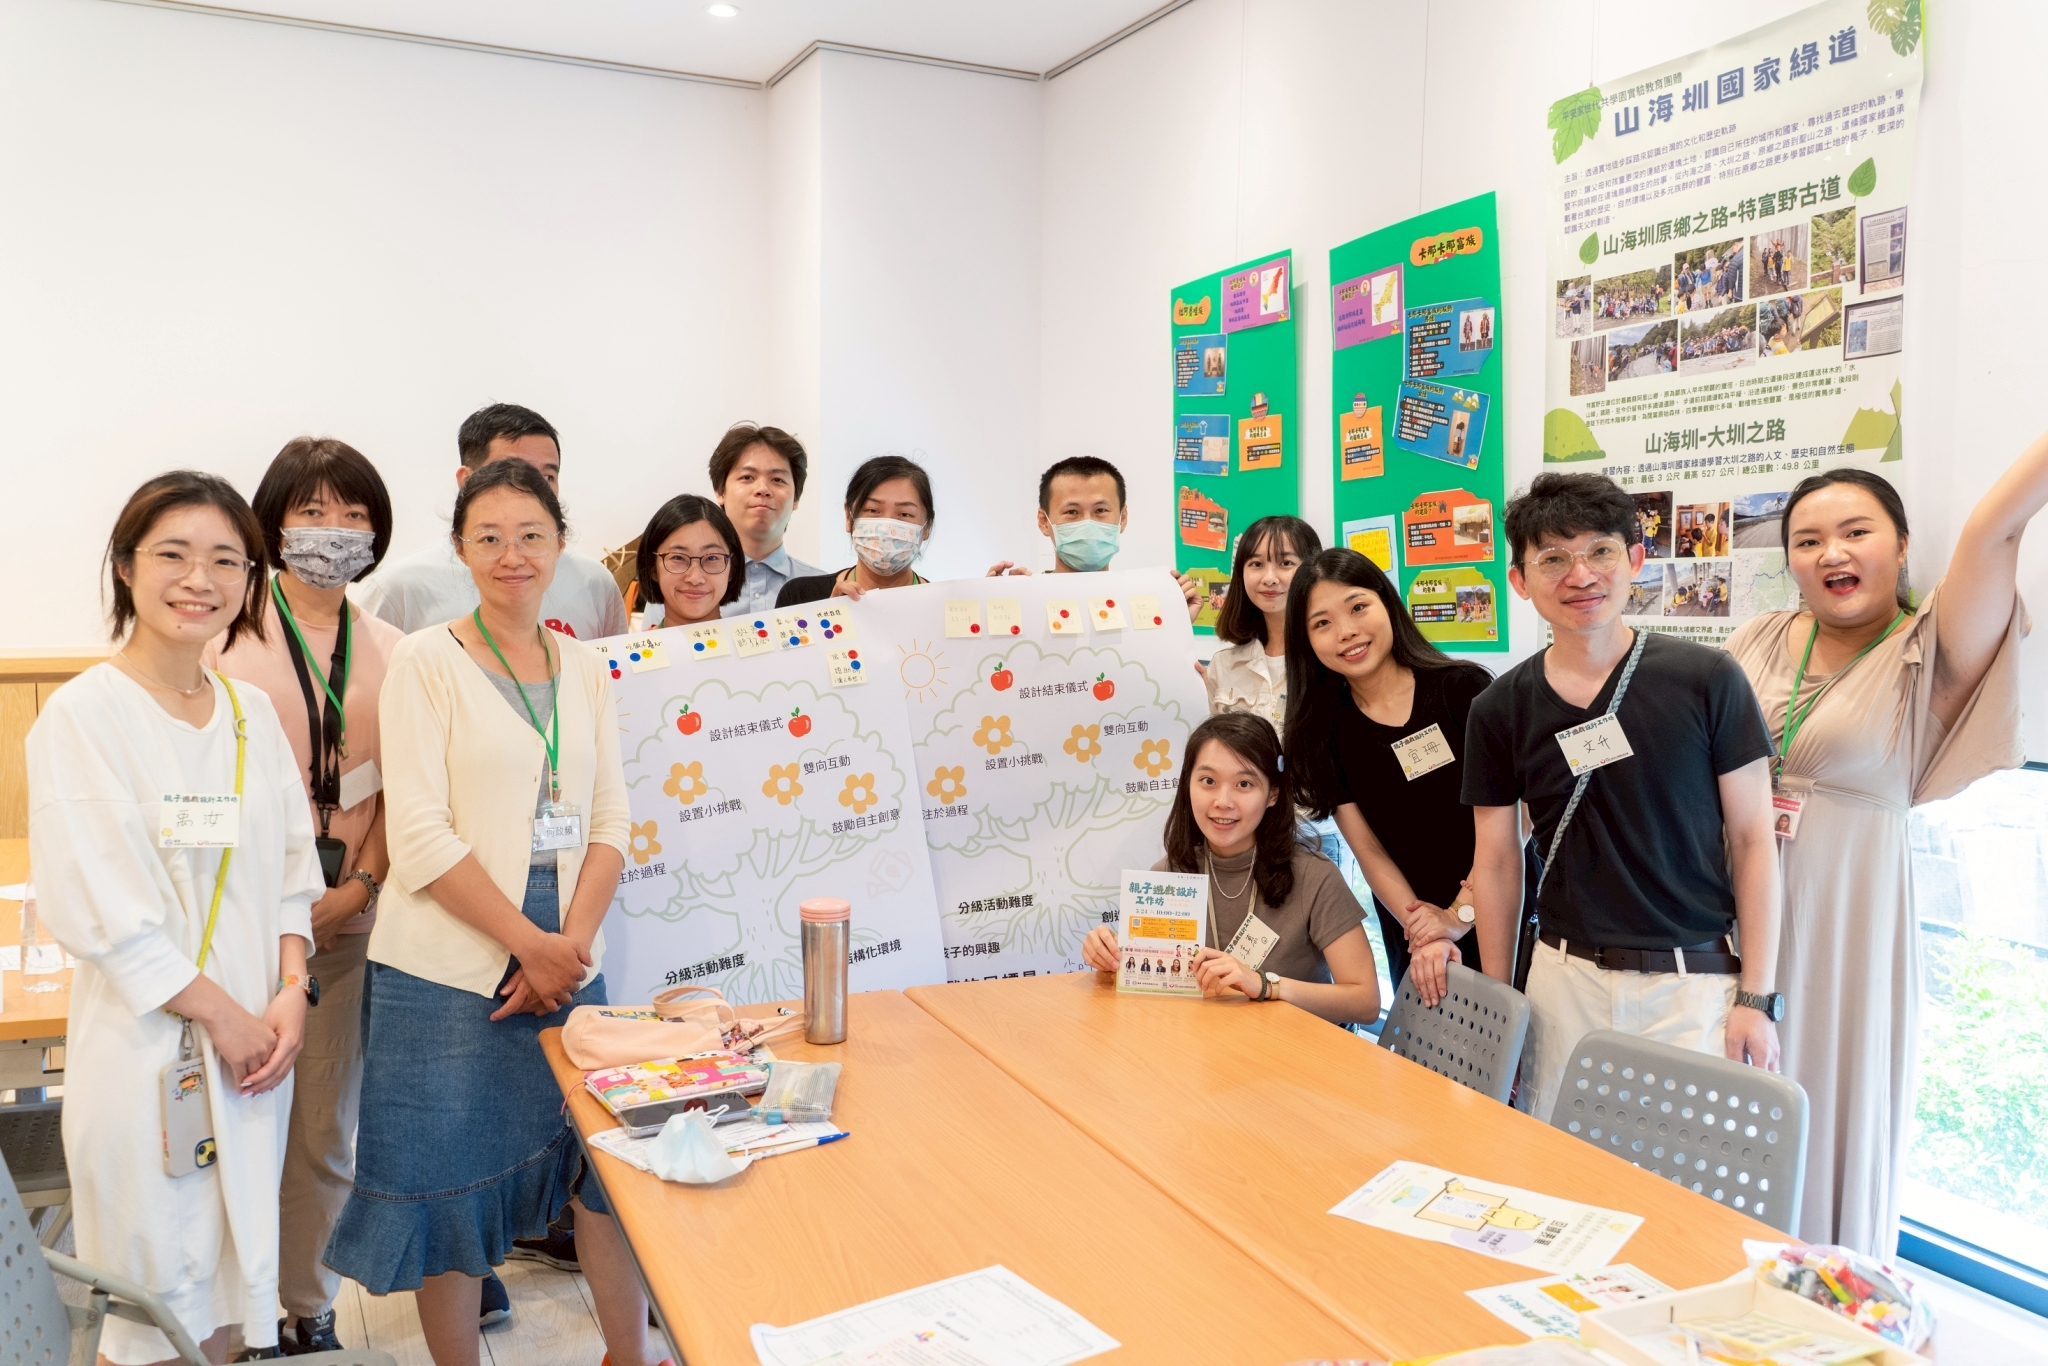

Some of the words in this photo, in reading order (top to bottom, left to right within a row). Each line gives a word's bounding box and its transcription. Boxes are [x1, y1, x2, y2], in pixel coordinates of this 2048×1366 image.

[1615, 26, 1857, 137] 山海圳國家綠道
[1603, 175, 1841, 256] 山海圳原鄉之路-特富野古道
[1645, 418, 1786, 454] 山海圳-大圳之路
[1702, 470, 1715, 478] 527
[1019, 681, 1089, 700] 設計結束儀式
[709, 716, 784, 742] 設計結束儀式
[1103, 720, 1149, 737] 雙向互動
[803, 754, 851, 775] 雙向互動
[985, 753, 1044, 771] 設置小挑戰
[679, 799, 743, 823] 設置小挑戰
[832, 808, 901, 834] 鼓勵自主創意
[922, 804, 968, 821] 注於過程
[1129, 882, 1198, 898] 親子遊戲設計
[958, 894, 1034, 914] 分級活動難度
[1135, 896, 1165, 906] 工作坊
[665, 953, 745, 986] 分級活動難度
